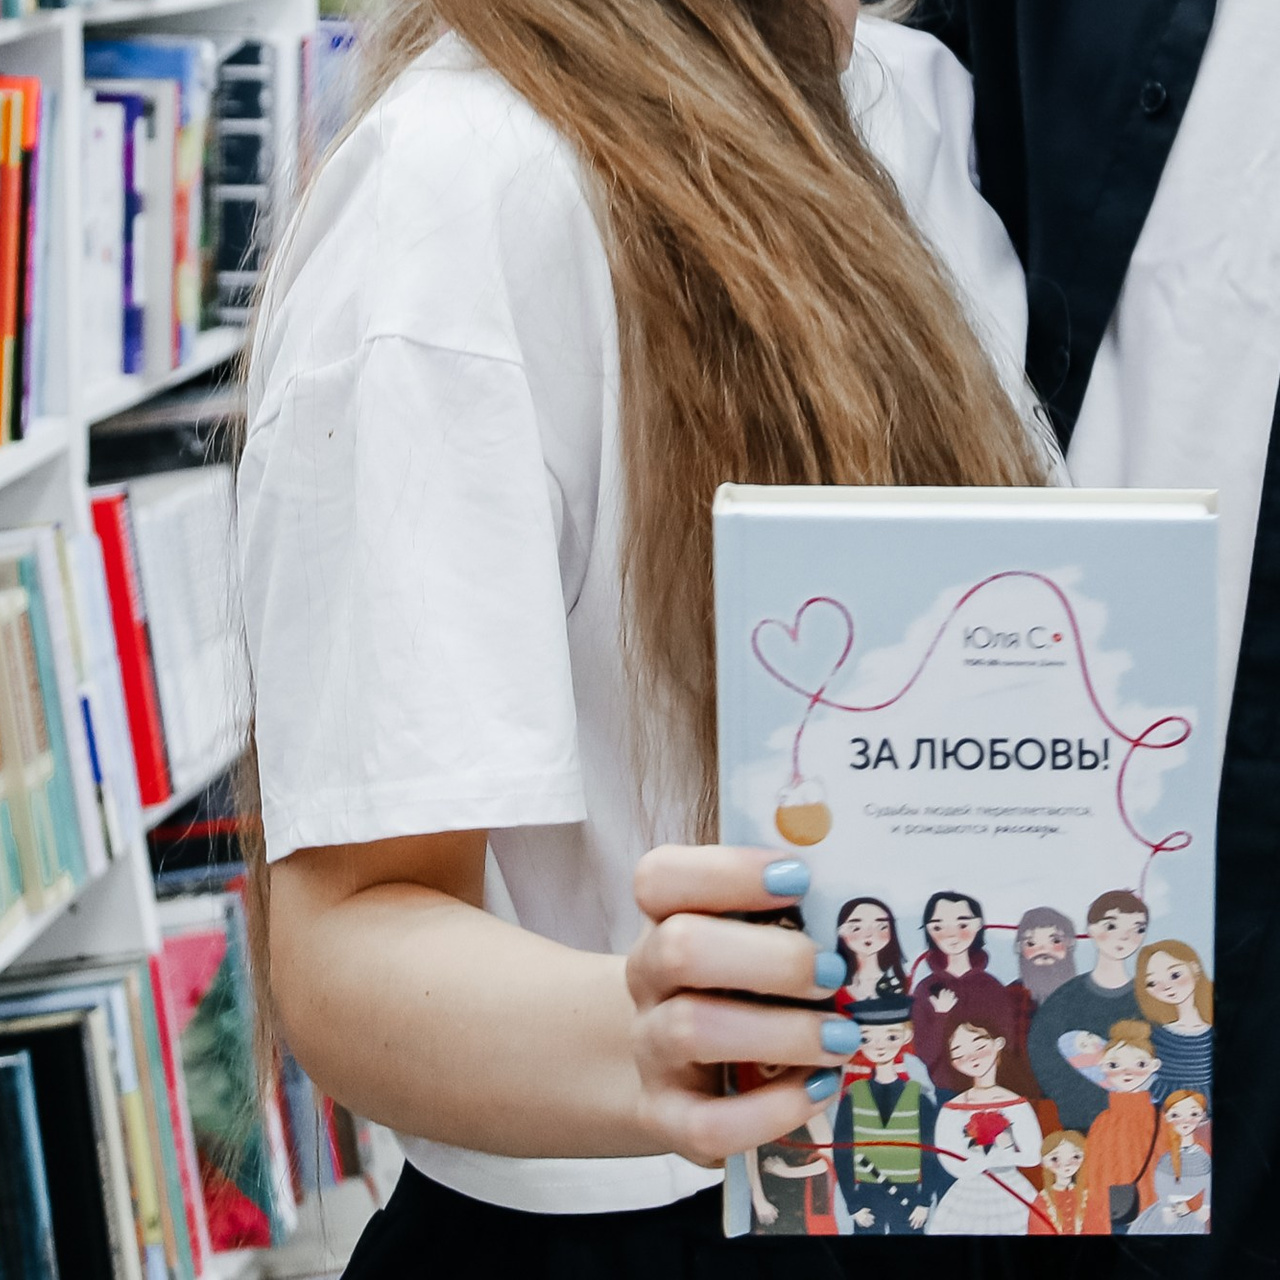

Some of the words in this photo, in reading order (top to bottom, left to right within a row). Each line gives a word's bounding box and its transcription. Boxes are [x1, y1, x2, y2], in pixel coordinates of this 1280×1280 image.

[963, 625, 1019, 649] Юля
[849, 737, 899, 770] ЗА
[909, 737, 1110, 771] ЛЮБОВЬ!
